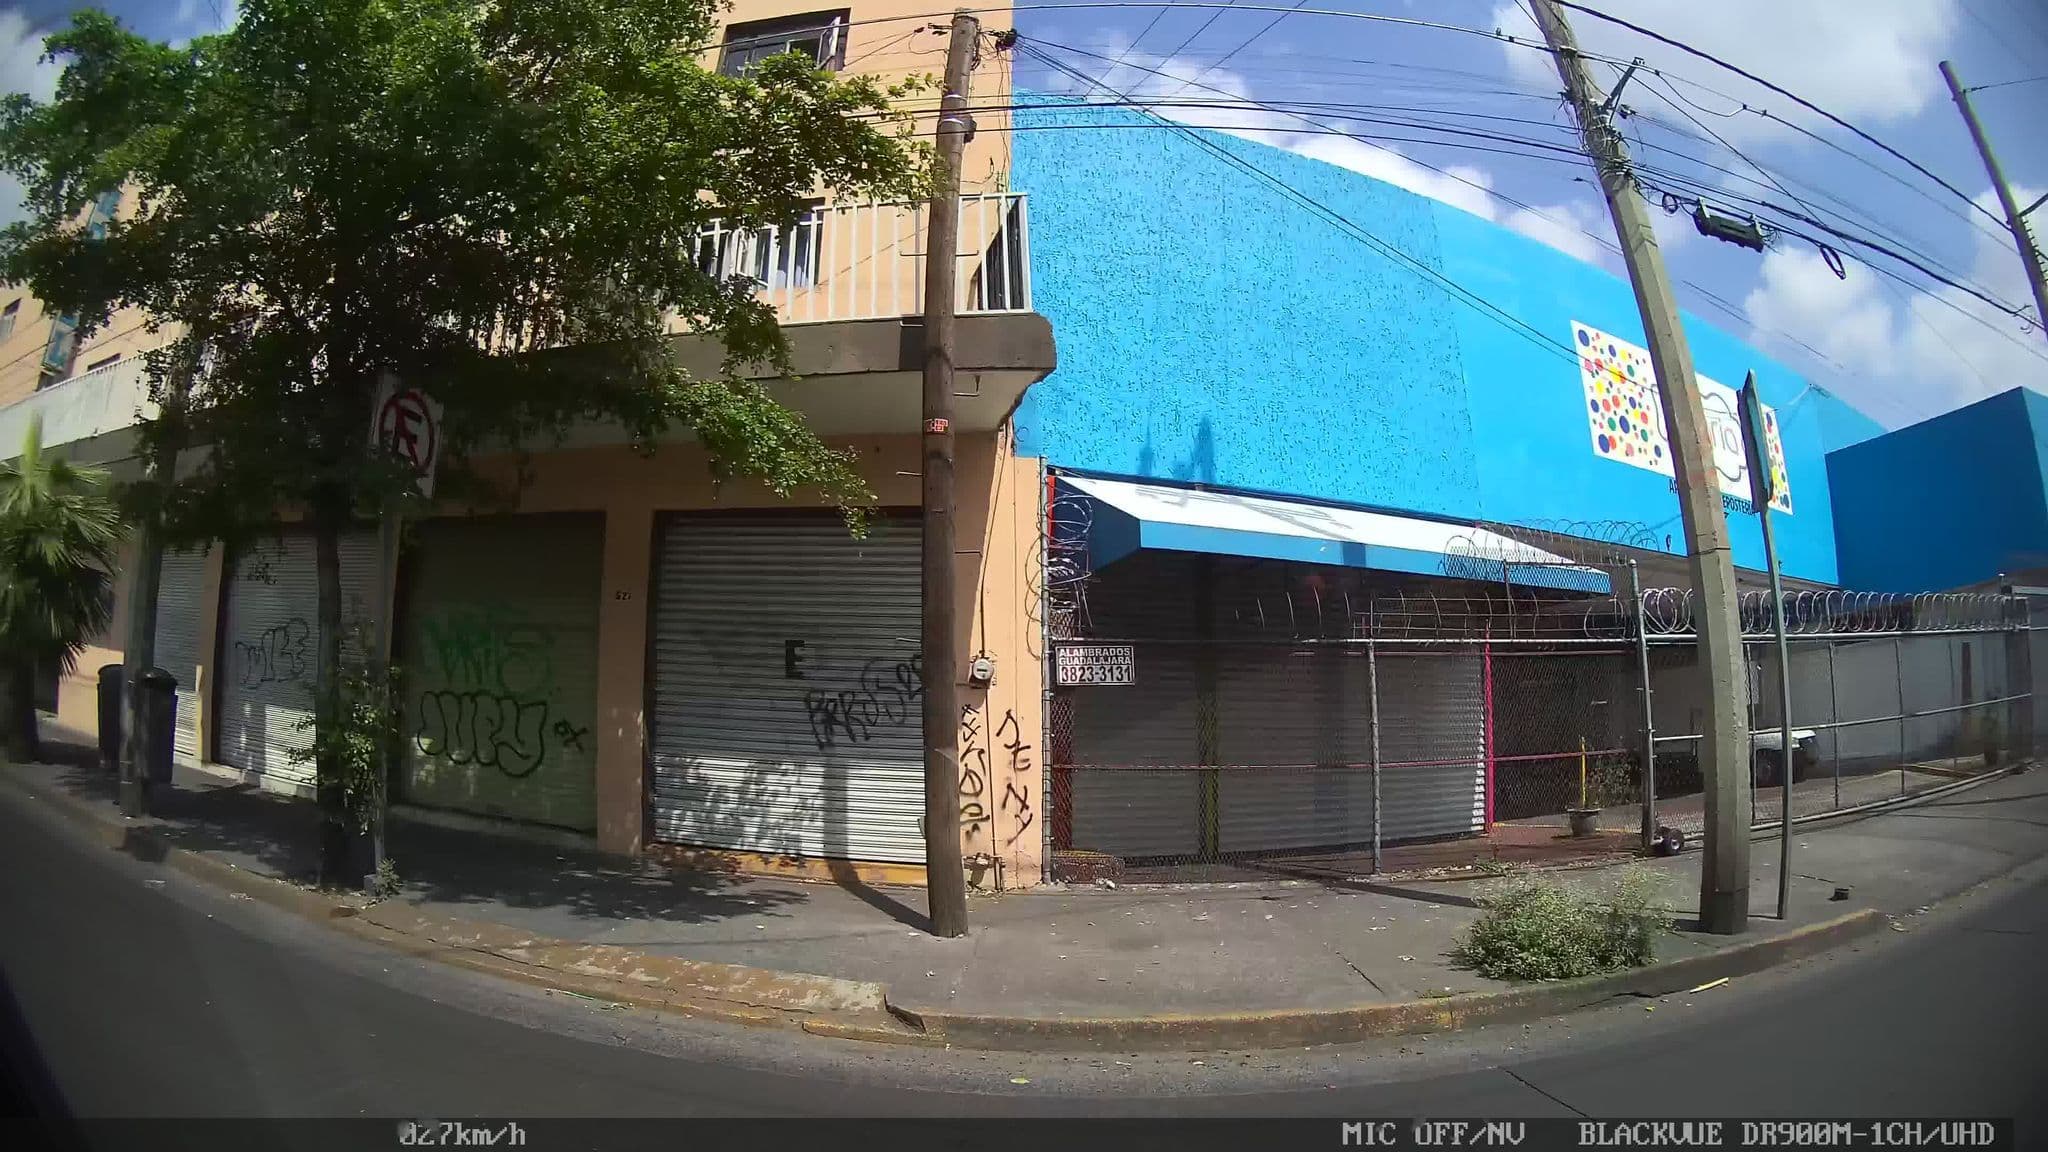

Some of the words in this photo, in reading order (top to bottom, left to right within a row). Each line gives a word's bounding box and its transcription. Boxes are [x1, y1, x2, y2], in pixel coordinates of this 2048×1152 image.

[1059, 647, 1130, 657] ALAMBRADOS
[1059, 656, 1131, 665] GUADALAJARA
[1061, 665, 1131, 682] 3823-3131
